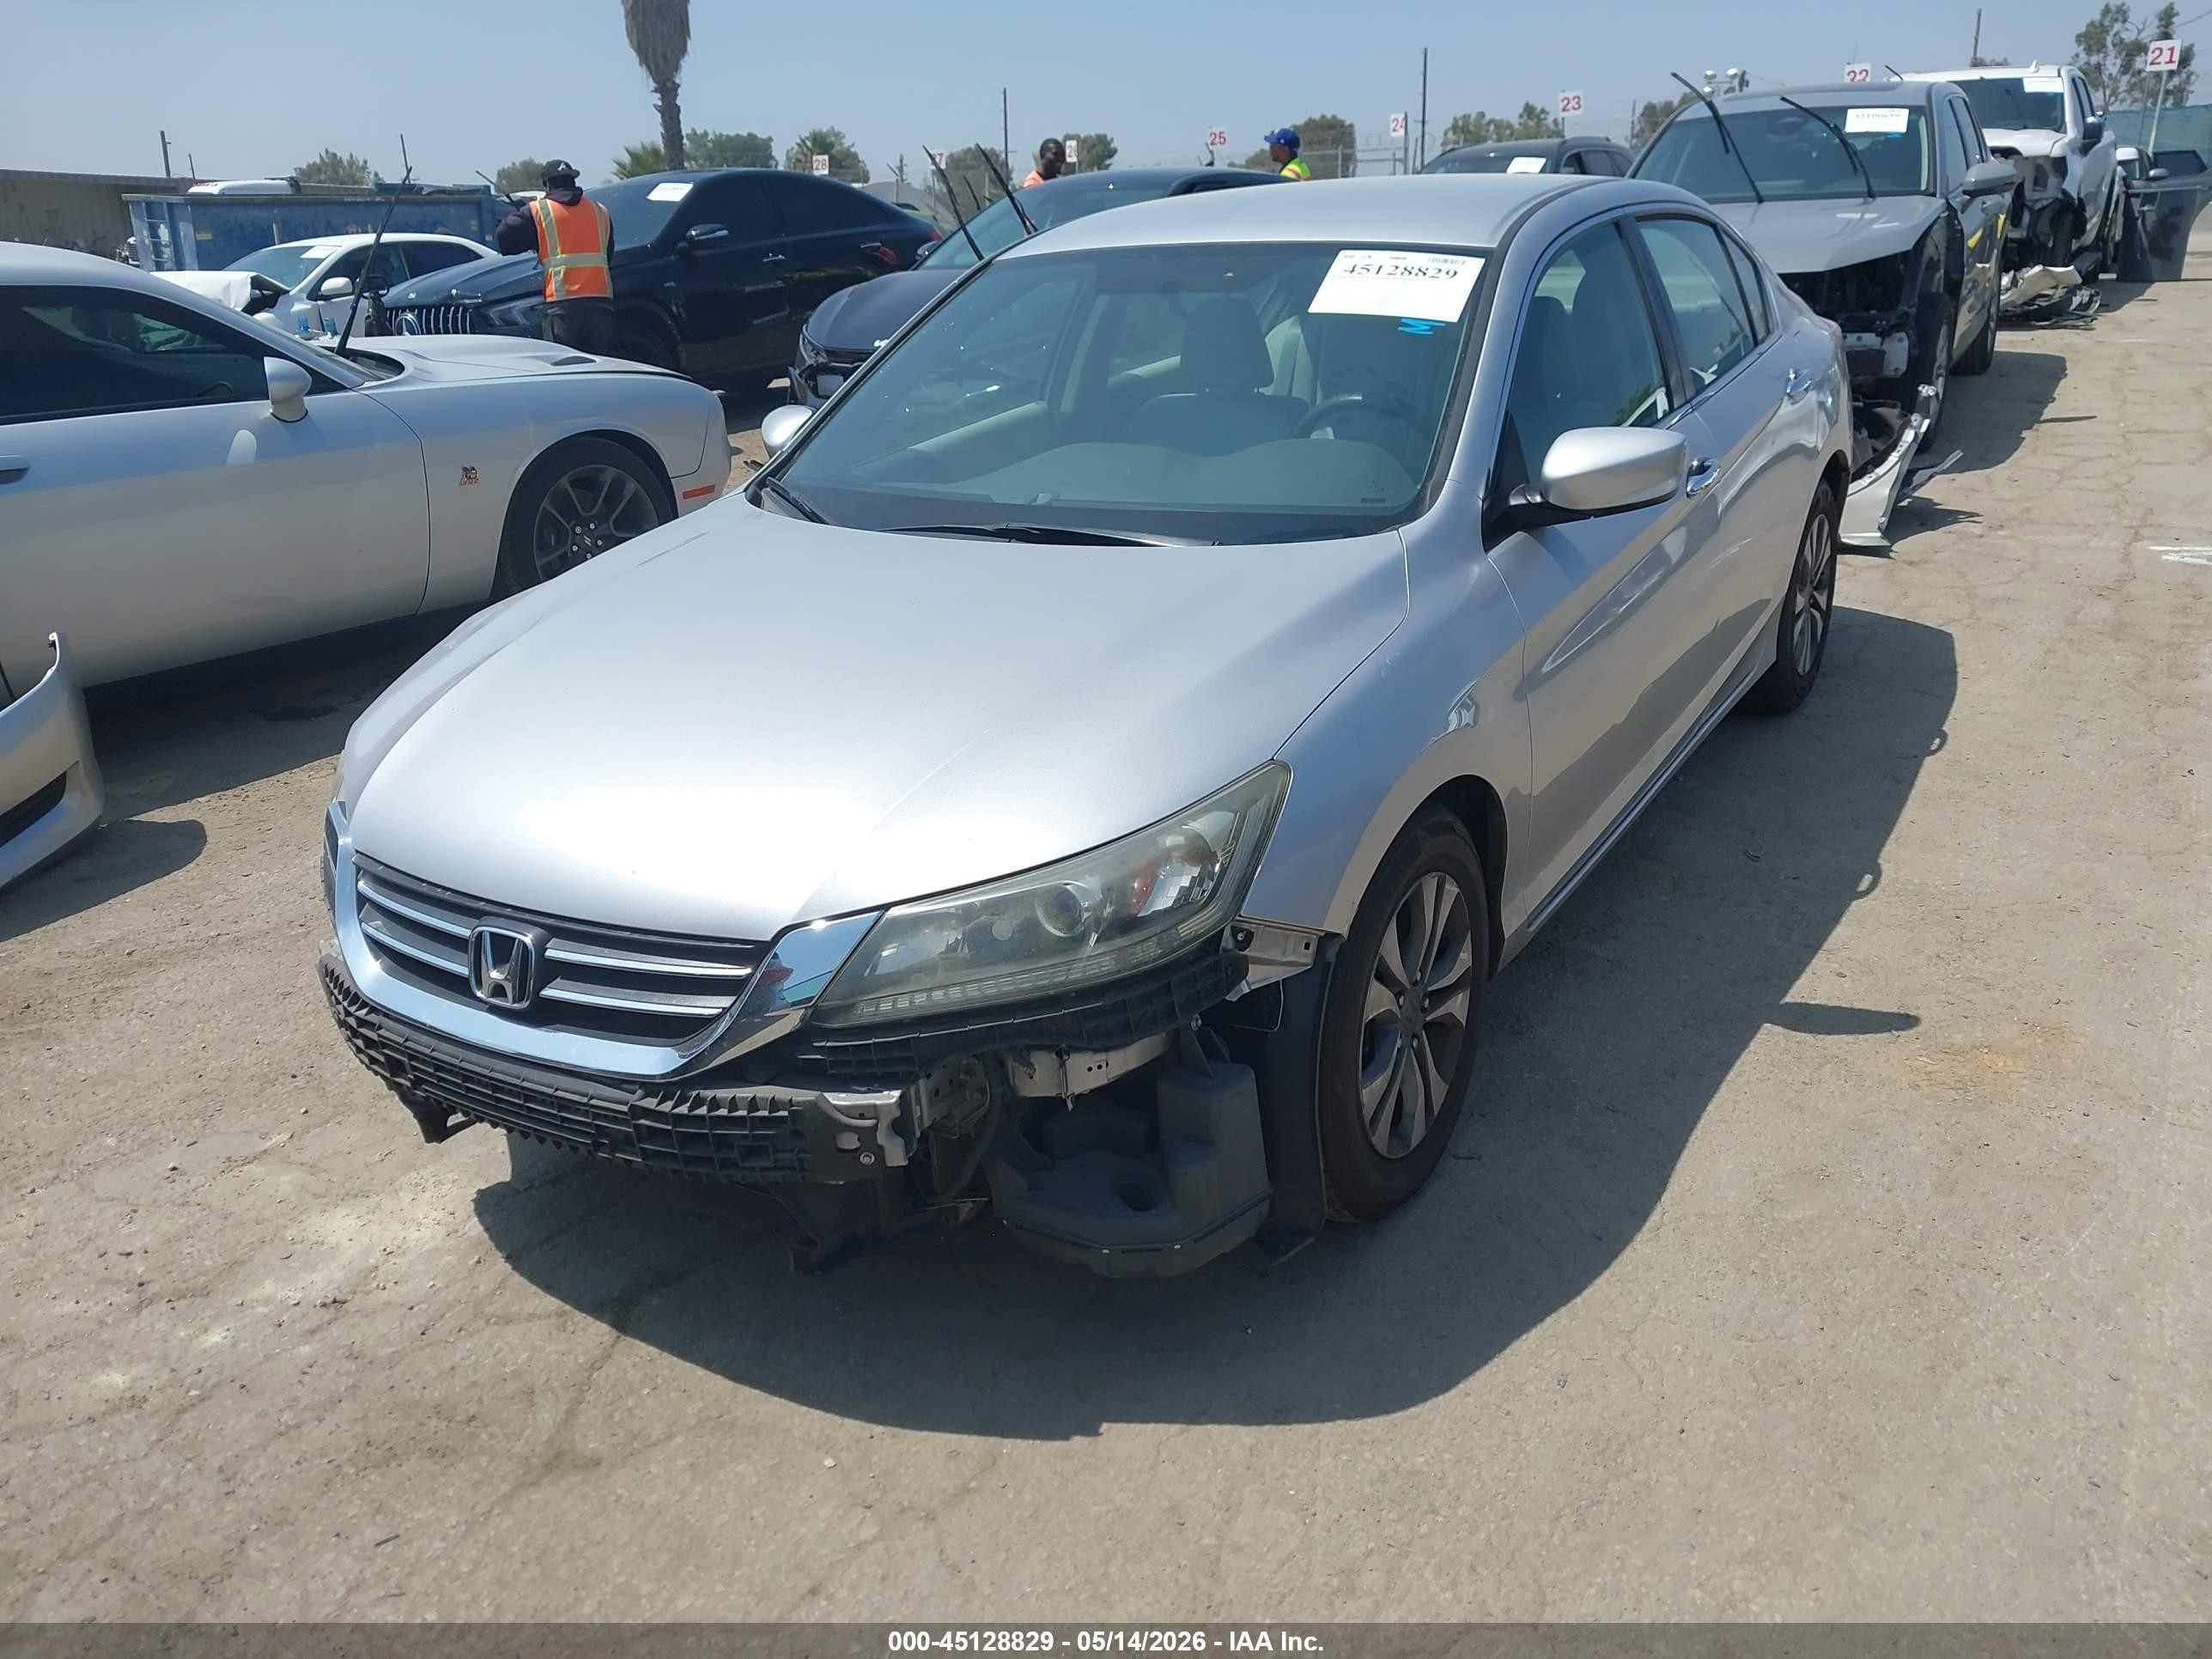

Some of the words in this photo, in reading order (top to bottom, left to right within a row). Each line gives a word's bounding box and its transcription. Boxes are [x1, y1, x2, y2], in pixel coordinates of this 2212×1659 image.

[2149, 46, 2176, 66] 21
[1561, 95, 1582, 112] 23
[1209, 131, 1226, 146] 25
[814, 159, 827, 171] 28
[1343, 263, 1458, 280] 45128829
